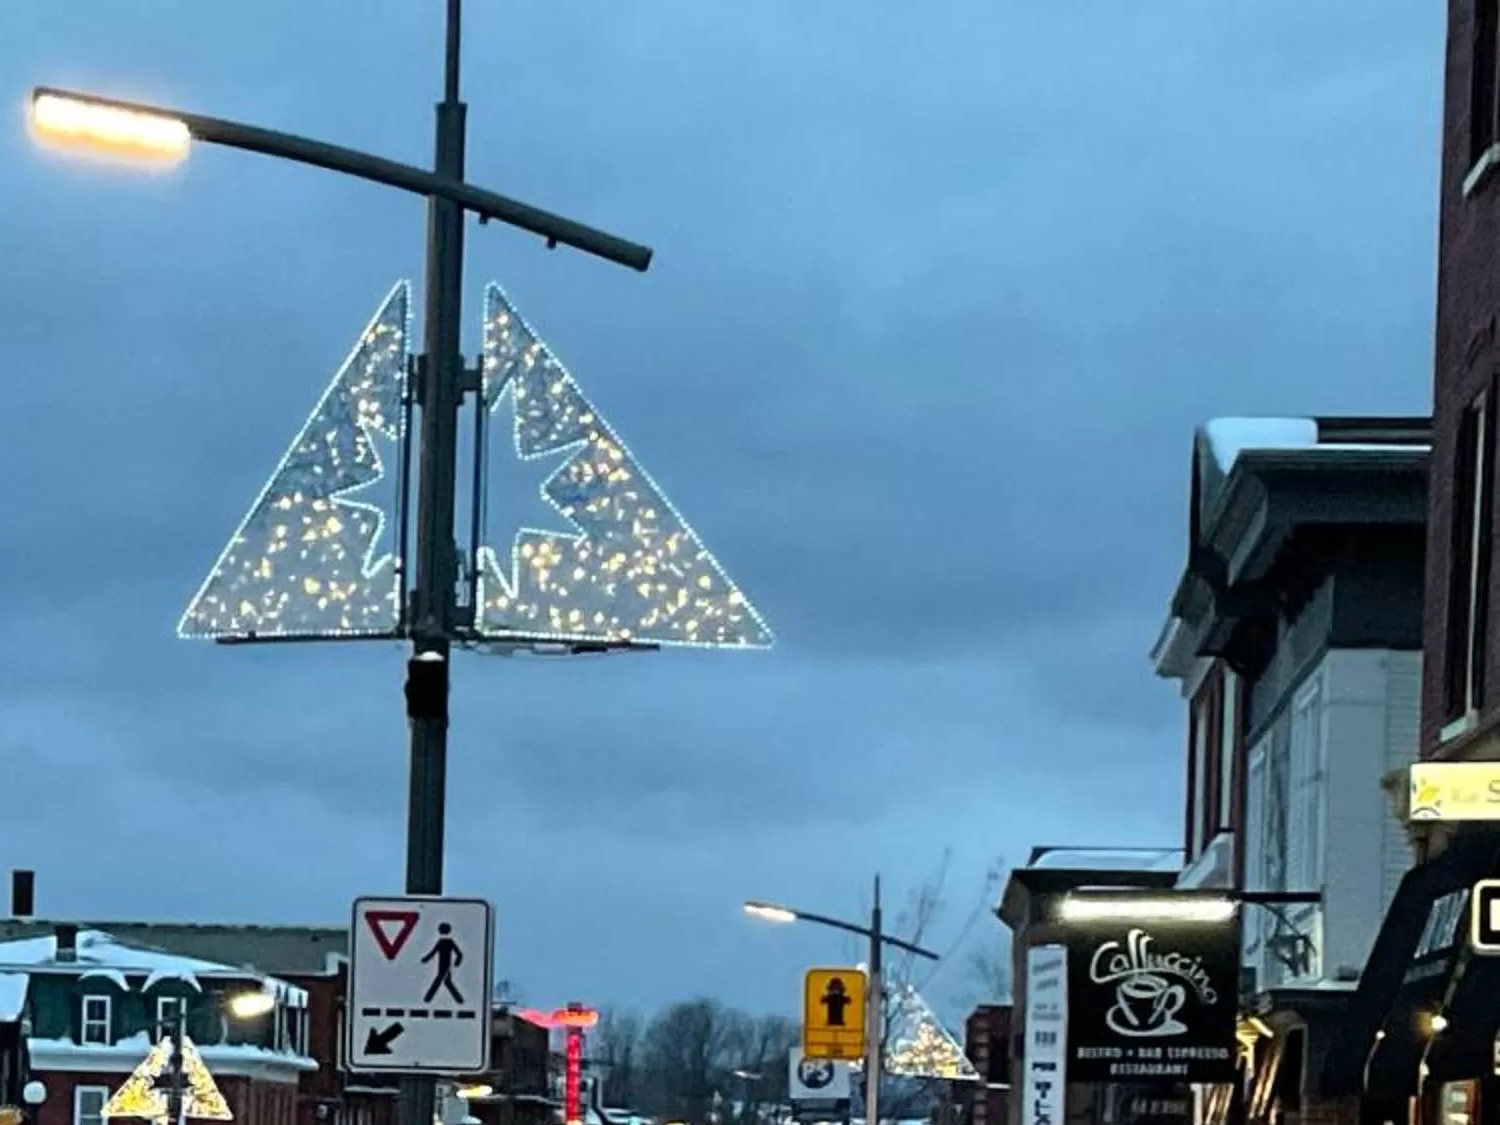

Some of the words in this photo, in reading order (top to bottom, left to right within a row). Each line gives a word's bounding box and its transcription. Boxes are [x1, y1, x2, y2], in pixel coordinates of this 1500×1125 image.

[1137, 1047, 1162, 1059] BAR
[1167, 1047, 1230, 1059] ESPRESSO
[1110, 1063, 1189, 1075] RESTAURANT
